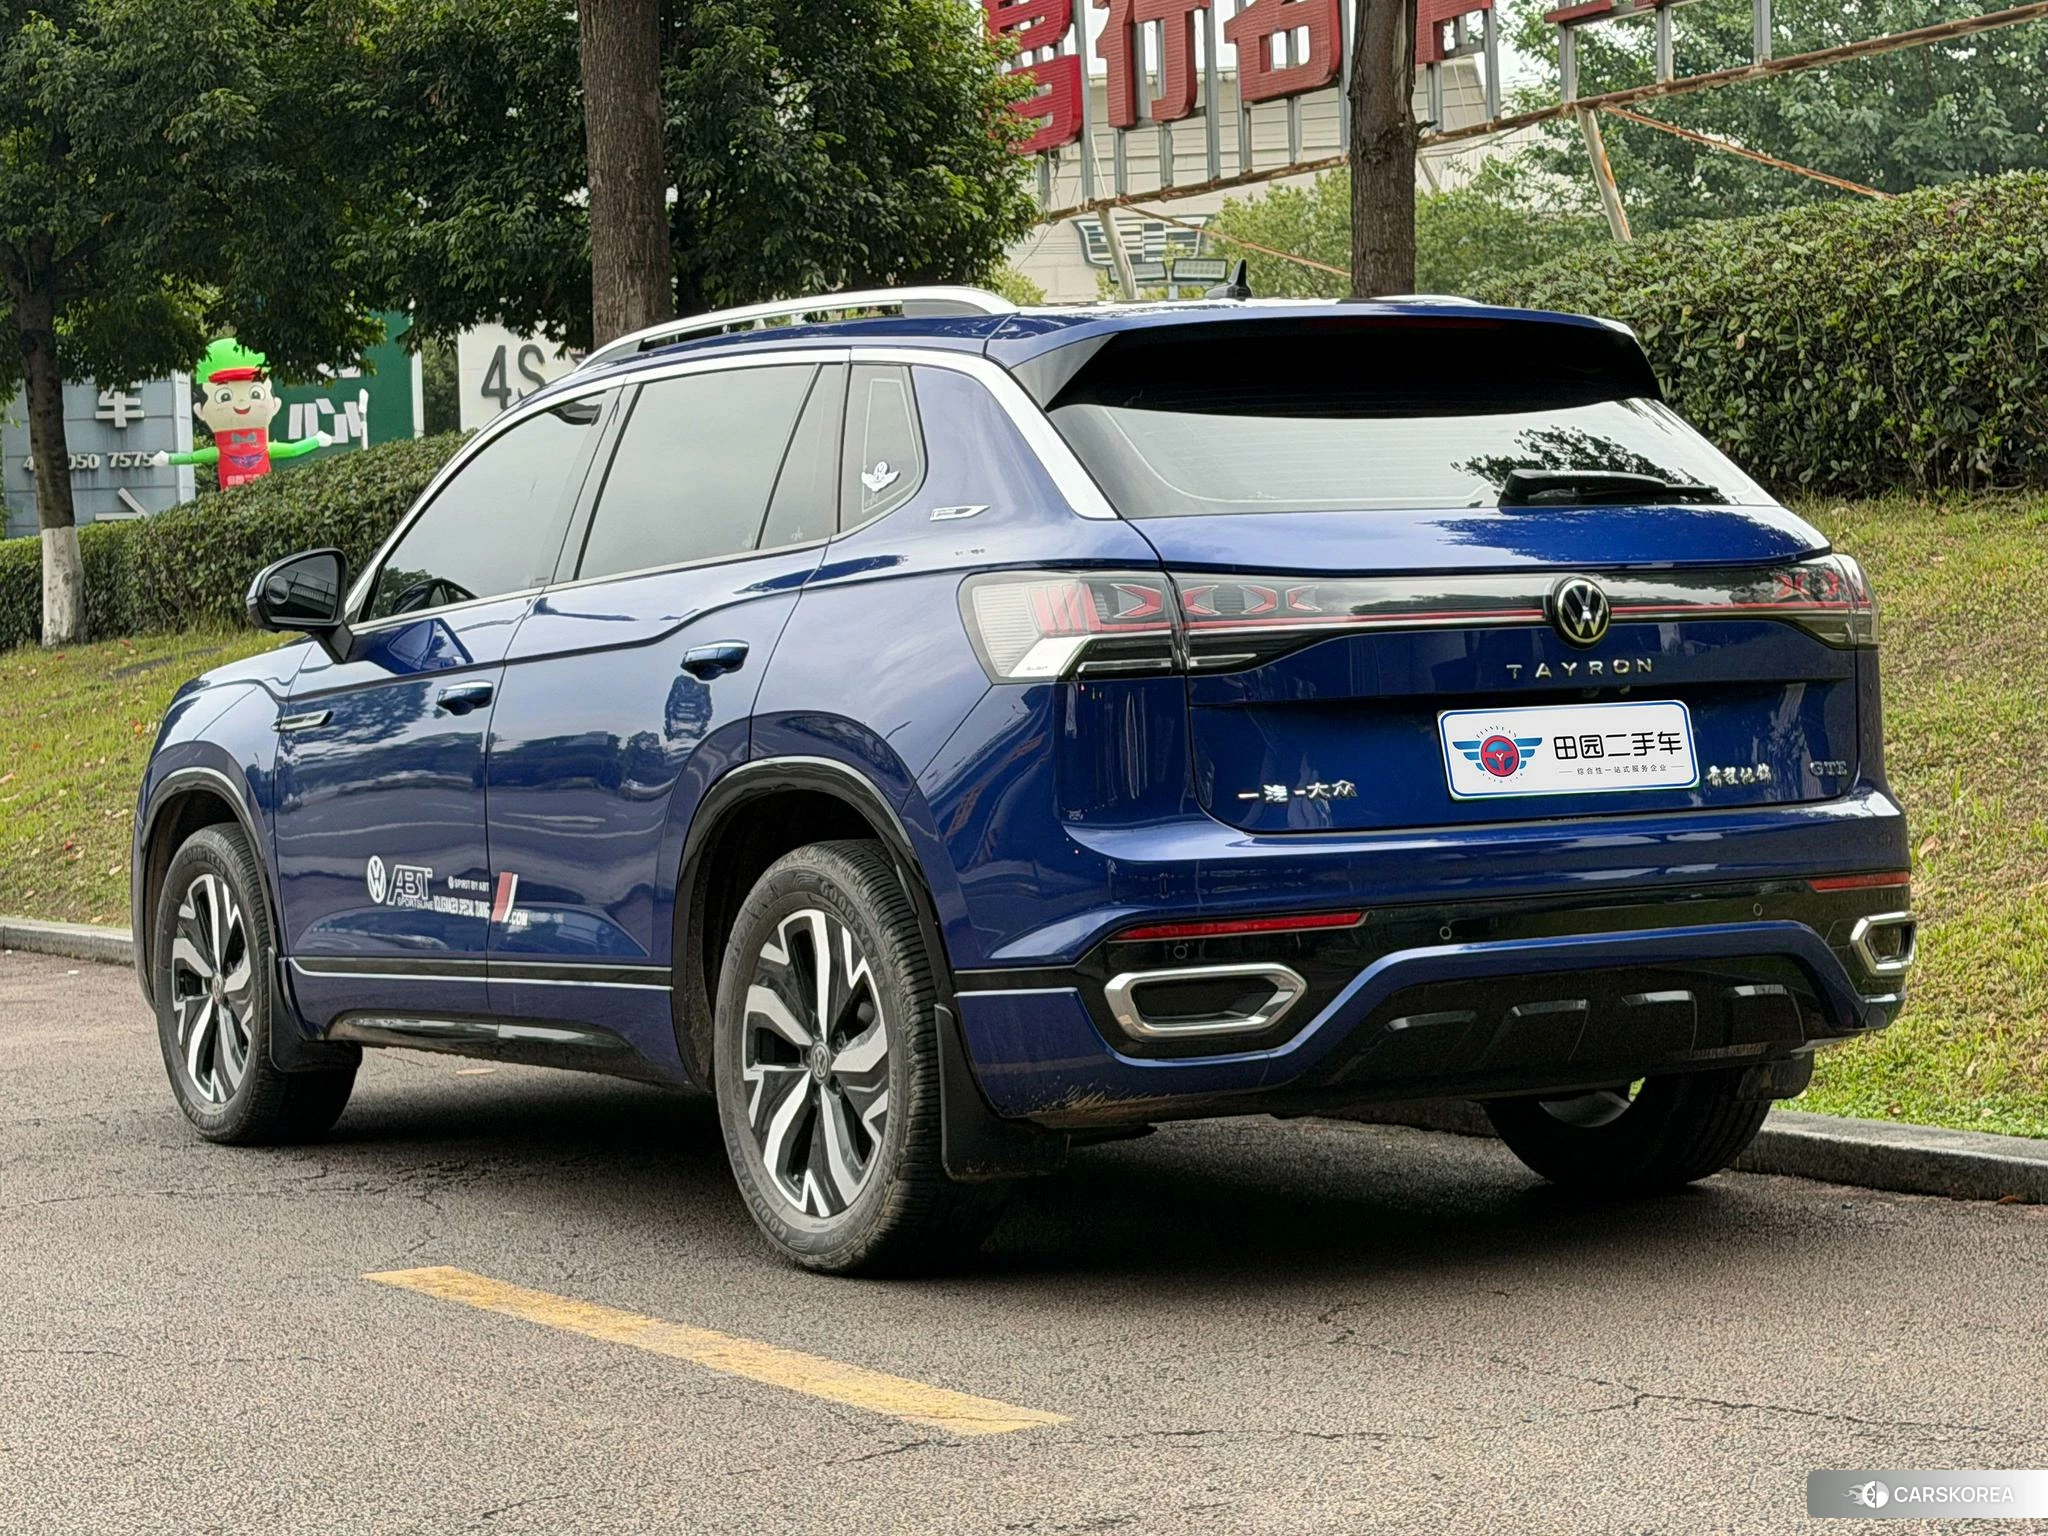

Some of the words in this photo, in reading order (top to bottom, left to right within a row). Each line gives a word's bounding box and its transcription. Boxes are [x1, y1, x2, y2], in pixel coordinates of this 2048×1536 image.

[481, 344, 547, 411] 4S
[107, 451, 153, 469] 7575
[1506, 657, 1653, 680] TAYRON
[1553, 731, 1683, 761] 田园二手车
[1576, 763, 1668, 776] 综合性一站式服务企业
[1809, 760, 1848, 776] GTE
